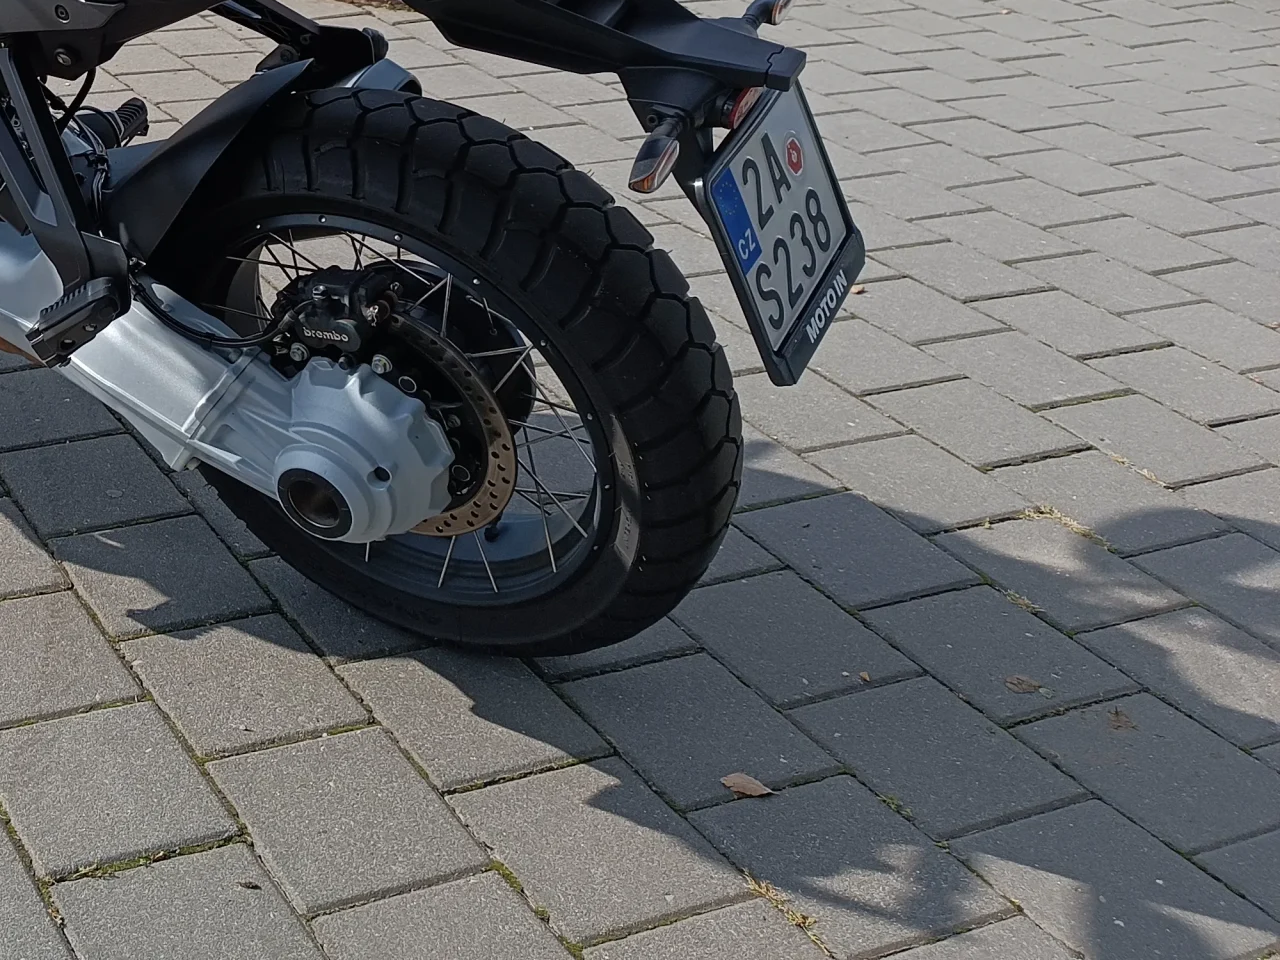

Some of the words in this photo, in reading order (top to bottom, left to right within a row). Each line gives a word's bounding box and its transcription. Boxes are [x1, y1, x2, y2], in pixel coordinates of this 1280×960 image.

[741, 131, 792, 231] 2A
[737, 227, 757, 261] CZ
[754, 187, 832, 331] S238
[302, 326, 349, 342] brembo
